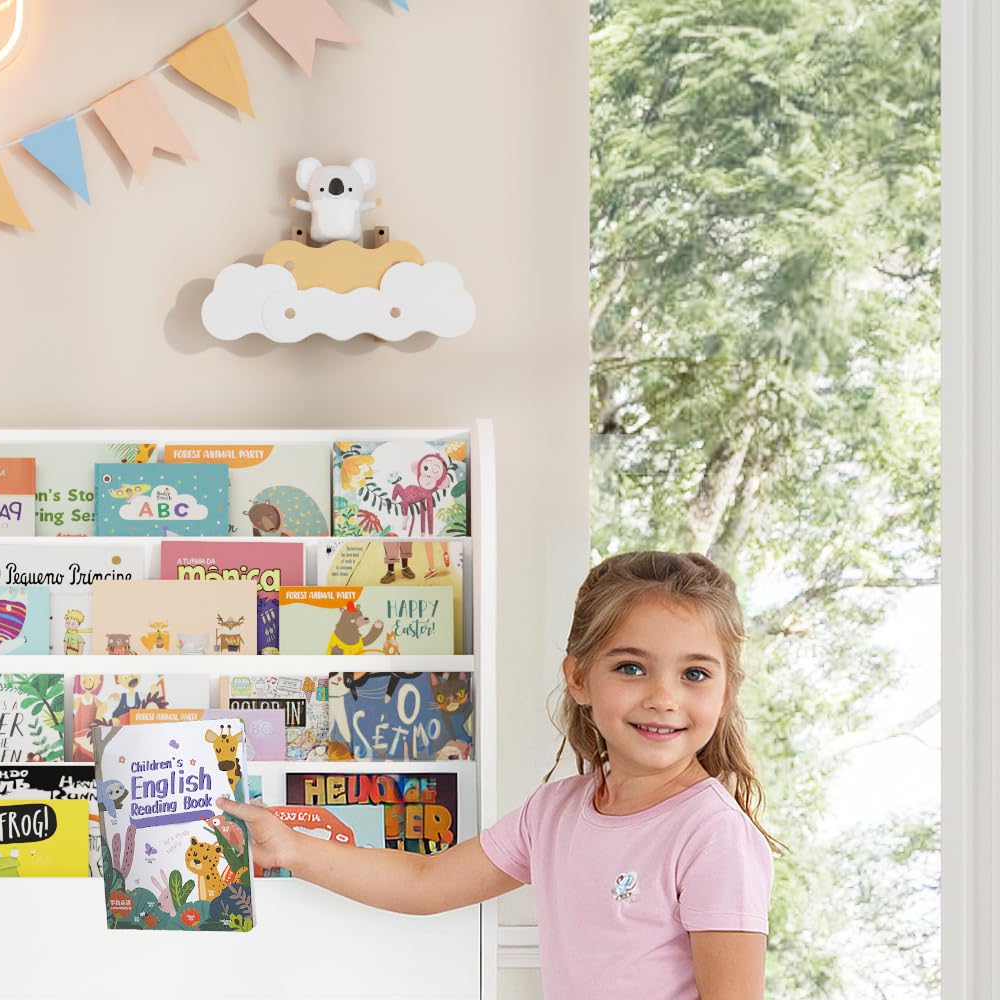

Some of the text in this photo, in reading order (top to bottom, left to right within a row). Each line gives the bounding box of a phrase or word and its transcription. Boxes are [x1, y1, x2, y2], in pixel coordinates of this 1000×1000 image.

[173, 449, 265, 459] FOREST ANIMAL PARTY
[5, 562, 64, 587] Pequeno
[286, 591, 356, 600] FOREST ANIMAL PARTY
[387, 600, 439, 618] HAPPY
[394, 617, 435, 639] Easter!
[397, 683, 421, 725] O
[131, 757, 184, 773] Children's
[131, 767, 212, 801] English
[130, 794, 213, 818] Reading Book
